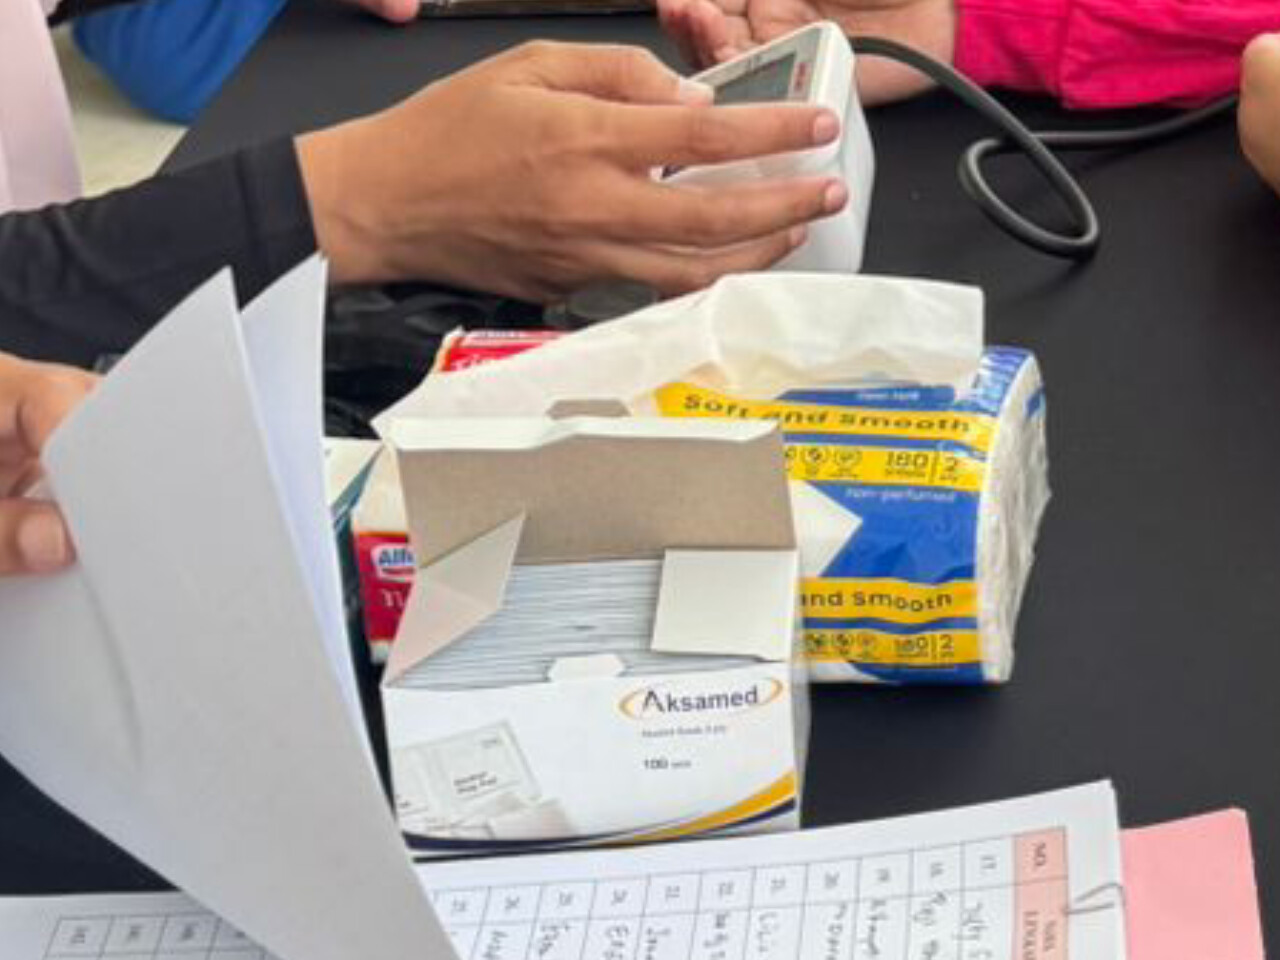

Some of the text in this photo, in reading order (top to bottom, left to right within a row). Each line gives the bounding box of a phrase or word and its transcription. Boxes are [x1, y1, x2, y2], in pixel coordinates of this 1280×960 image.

[683, 393, 750, 419] Soft
[839, 413, 971, 433] smooth
[885, 451, 959, 473] 180 2
[939, 633, 955, 651] 2
[643, 684, 759, 713] Aksamed
[643, 758, 669, 770] 100
